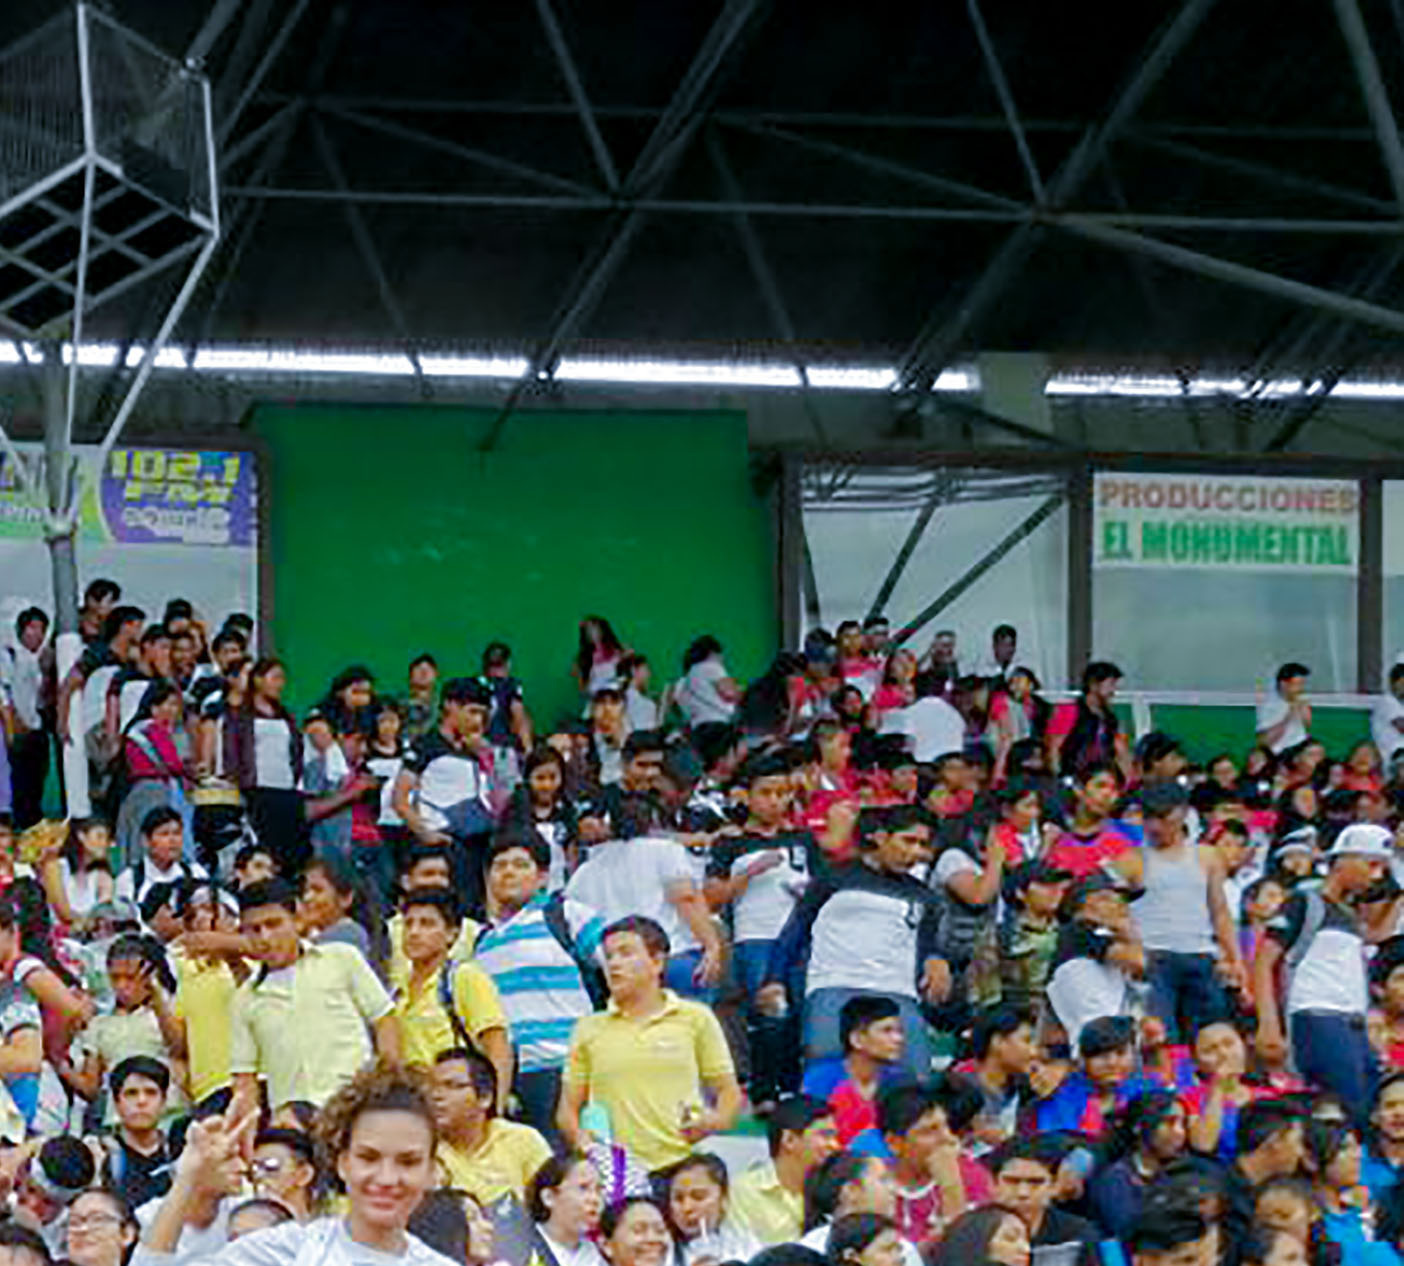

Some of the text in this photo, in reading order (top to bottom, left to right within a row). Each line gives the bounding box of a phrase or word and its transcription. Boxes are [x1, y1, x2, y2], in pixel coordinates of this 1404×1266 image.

[1100, 480, 1356, 513] PRODUCCIONES
[1101, 520, 1352, 565] EL MONUMENTAL
